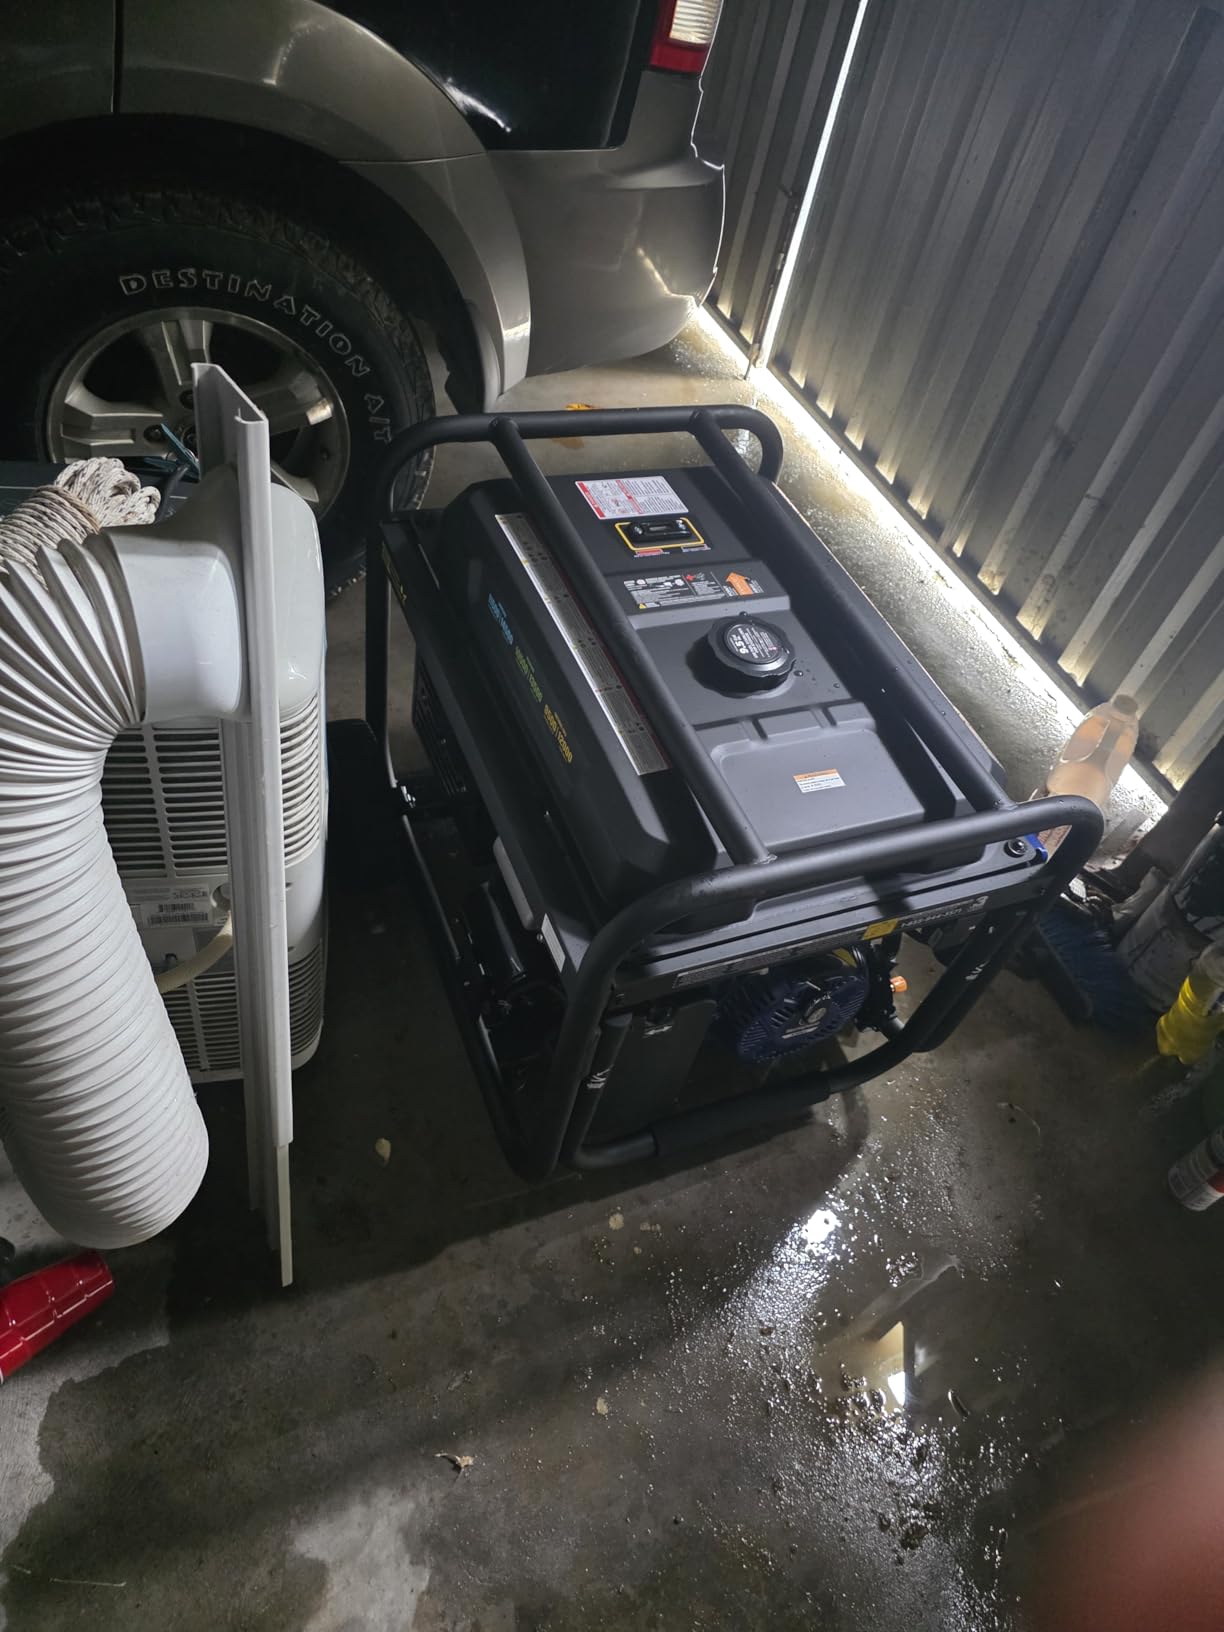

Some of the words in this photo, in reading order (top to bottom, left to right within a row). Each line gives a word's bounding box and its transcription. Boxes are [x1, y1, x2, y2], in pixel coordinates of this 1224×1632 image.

[119, 268, 370, 377] DESTINATION
[364, 393, 392, 444] A/T
[735, 640, 749, 654] 9.5
